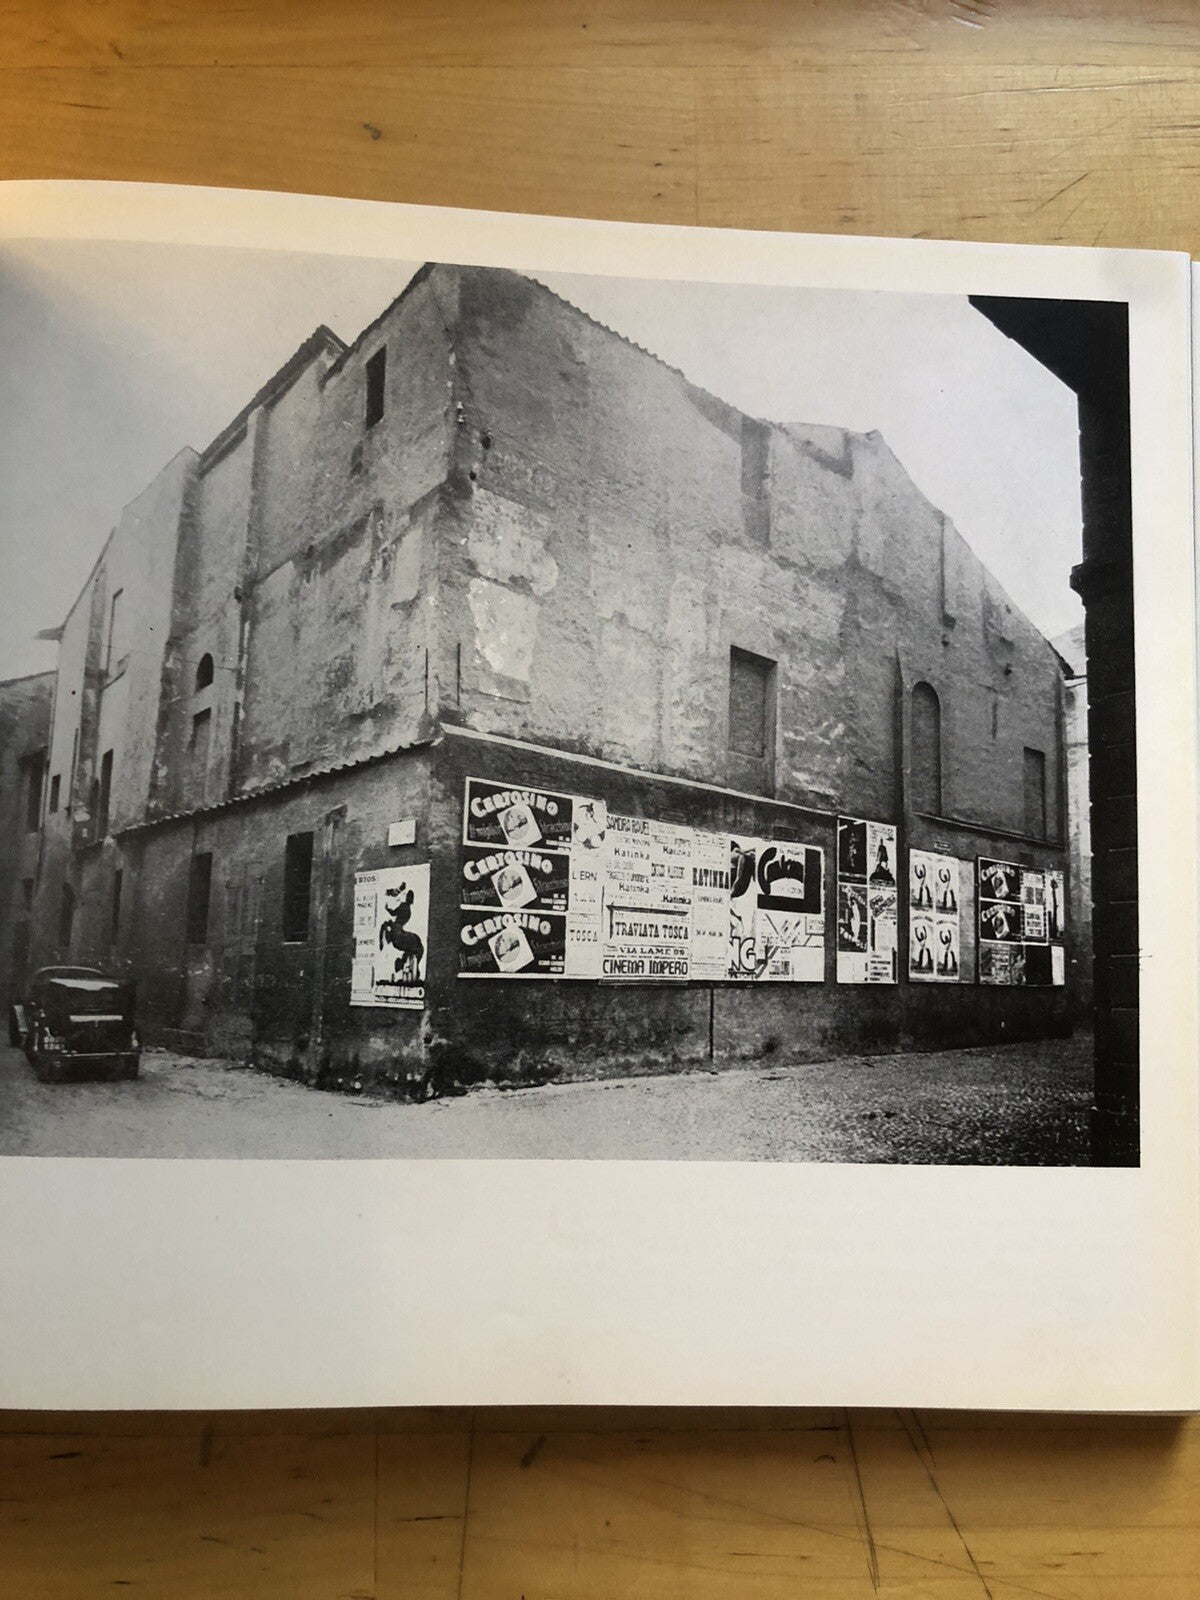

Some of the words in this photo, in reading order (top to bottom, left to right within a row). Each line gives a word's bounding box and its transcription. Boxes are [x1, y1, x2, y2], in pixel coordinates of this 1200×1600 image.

[460, 913, 552, 946] CERTOSINO
[615, 921, 660, 938] TRAVIATA
[662, 924, 689, 939] TOSCA
[602, 959, 645, 974] CINEMA
[648, 960, 689, 976] IMPERO
